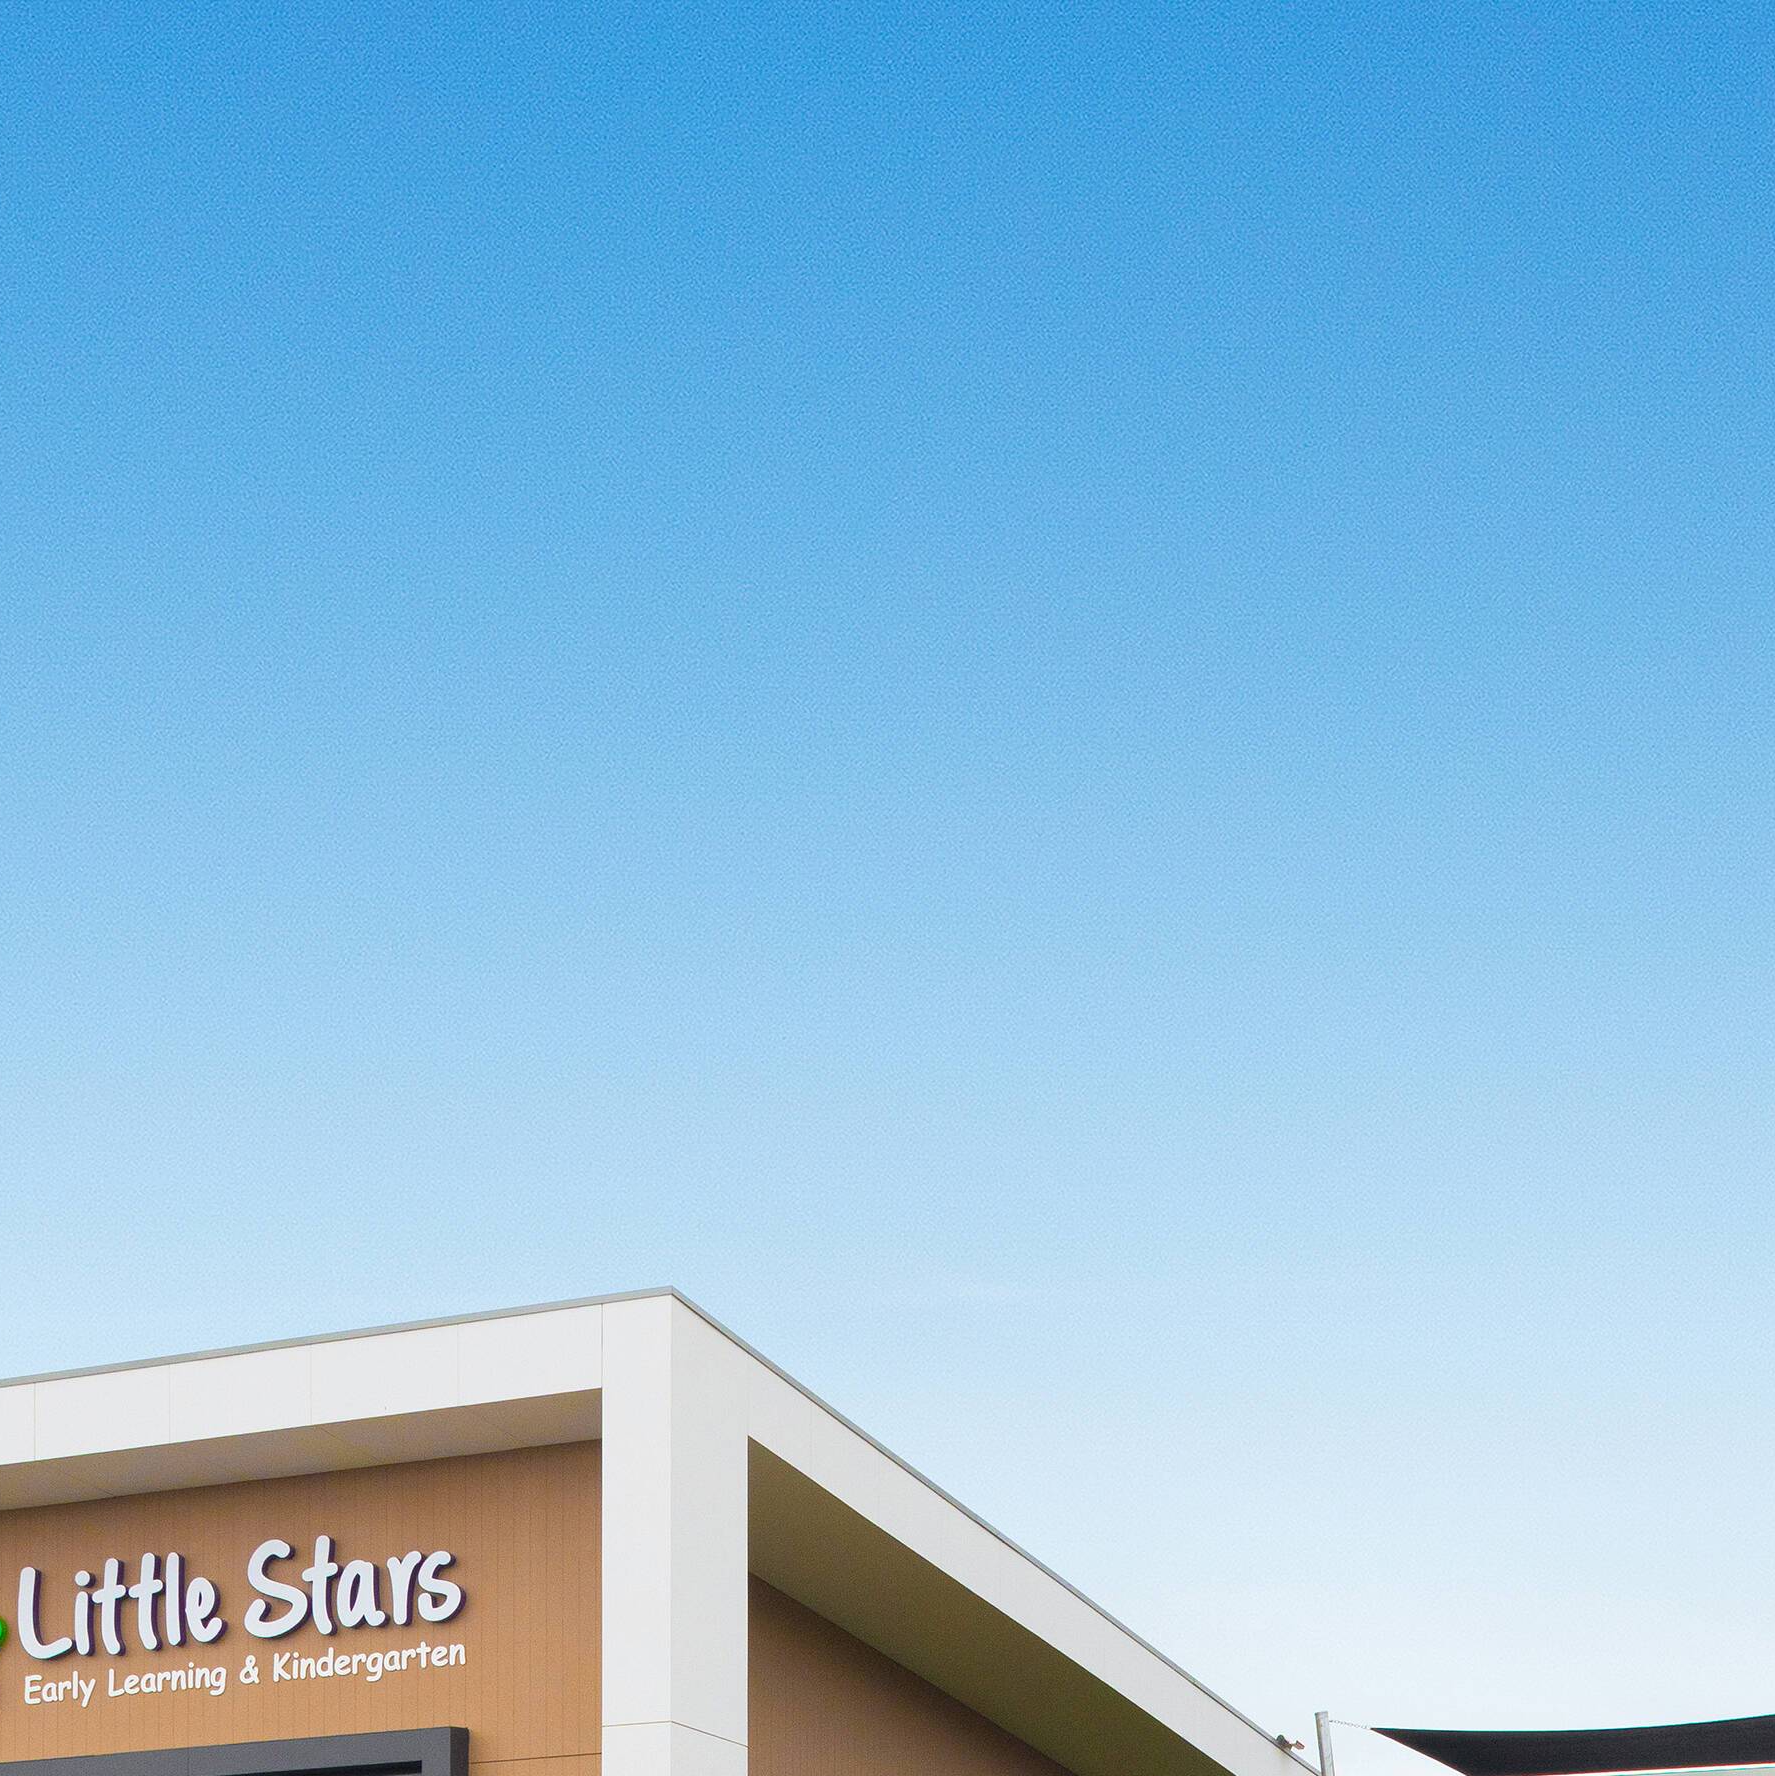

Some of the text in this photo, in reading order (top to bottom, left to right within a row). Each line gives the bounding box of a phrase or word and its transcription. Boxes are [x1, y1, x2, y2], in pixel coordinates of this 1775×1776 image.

[16, 1534, 465, 1660] Little Stars
[23, 1641, 467, 1708] Early Learning & Kindergarten
